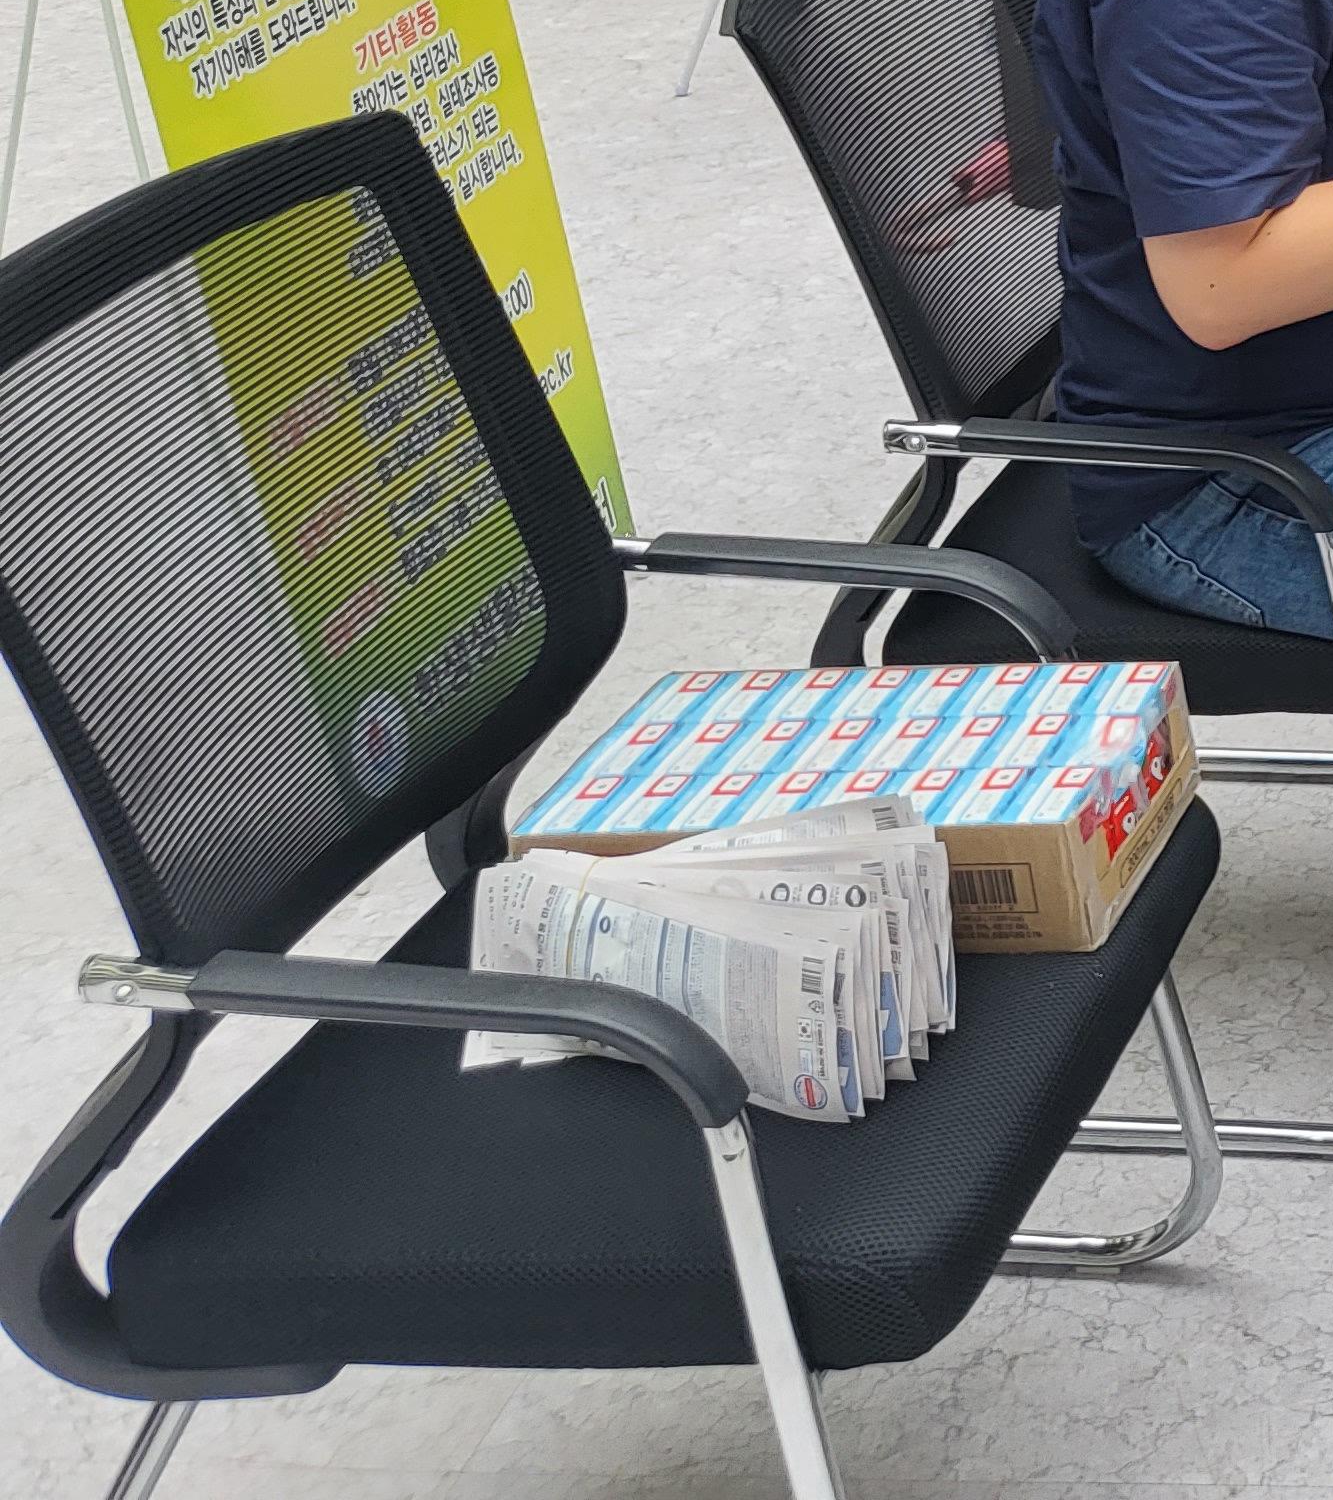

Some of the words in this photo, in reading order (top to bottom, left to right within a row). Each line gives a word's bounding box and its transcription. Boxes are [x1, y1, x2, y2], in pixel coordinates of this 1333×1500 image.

[160, 4, 211, 59] 자신의
[354, 0, 440, 73] 기타활동
[190, 36, 270, 100] 자기이해를
[352, 69, 409, 115] 찾아가는
[408, 31, 461, 92] 심리검사
[437, 54, 500, 120] 실태조사등
[471, 104, 499, 141] 되는
[541, 884, 559, 919] 마스크
